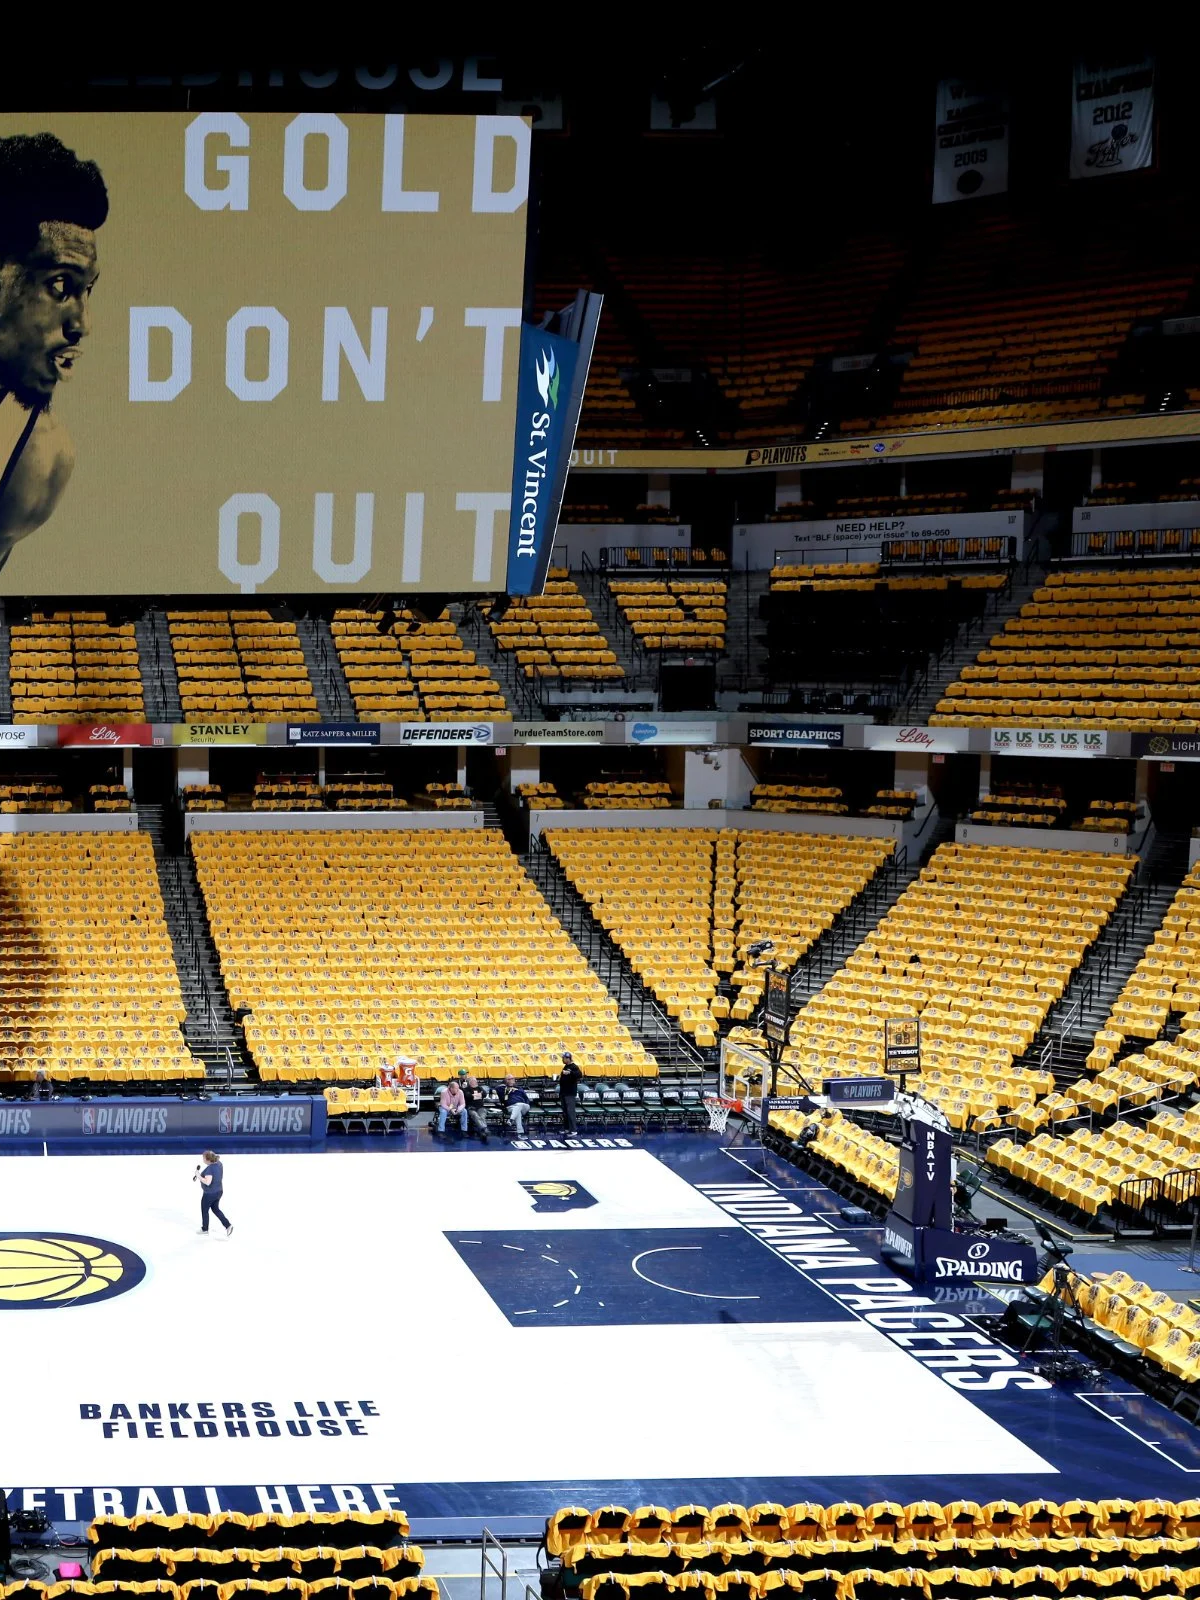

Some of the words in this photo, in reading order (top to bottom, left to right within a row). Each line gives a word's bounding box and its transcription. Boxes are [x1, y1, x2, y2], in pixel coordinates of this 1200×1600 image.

[1093, 102, 1133, 125] 2012
[184, 112, 532, 213] GOLD
[954, 149, 988, 167] 2009
[528, 411, 551, 446] St.
[761, 446, 807, 465] PLAYOFFS
[516, 448, 549, 558] Vincent
[836, 523, 866, 532] NEED
[869, 522, 905, 532] HELP?
[218, 492, 512, 594] QUIT
[833, 533, 862, 542] (space)
[863, 533, 882, 541] your
[88, 727, 122, 745] Lilly
[190, 725, 249, 735] STANLEY
[190, 736, 216, 744] Security
[320, 730, 345, 738] SAPPER
[352, 730, 377, 738] MILLER
[402, 728, 473, 741] DEFENDERS
[513, 728, 604, 739] PurdueTeamStore.com
[749, 728, 784, 740] SPORT
[785, 728, 842, 741] GRAPHICS
[896, 728, 935, 749] Lilly
[850, 1084, 883, 1098] PLAYOFFS
[96, 1107, 168, 1134] PLAYOFFS
[233, 1106, 305, 1133] PLAYOFFS
[926, 1131, 936, 1160] NBA
[926, 1162, 936, 1182] TV
[935, 1257, 1024, 1282] SPALDING
[693, 1183, 880, 1270] INDIANA
[815, 1277, 1054, 1391] PACERS
[80, 1401, 277, 1420] BANKERS
[299, 1400, 381, 1418] LIFE
[102, 1419, 370, 1439] FIELDHOUSE
[254, 1484, 402, 1516] HERE
